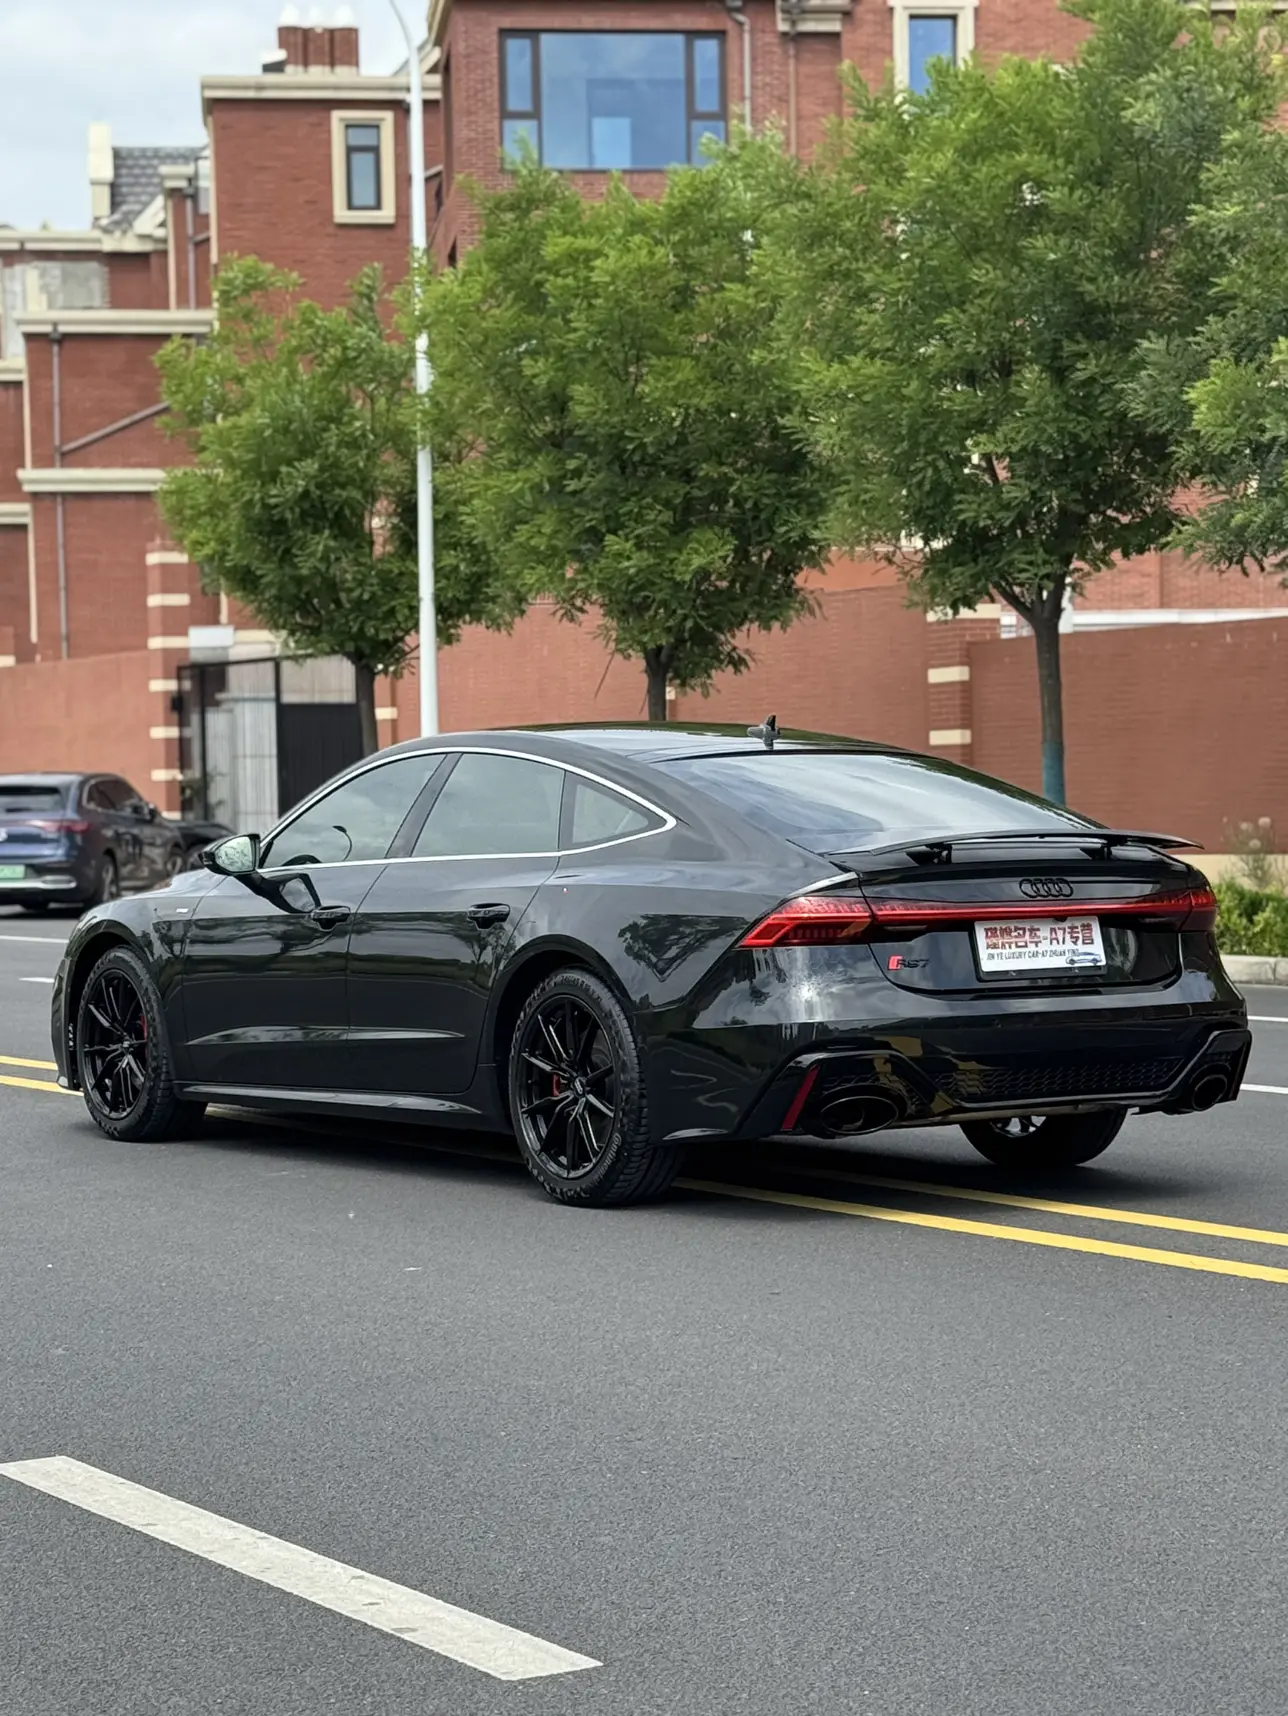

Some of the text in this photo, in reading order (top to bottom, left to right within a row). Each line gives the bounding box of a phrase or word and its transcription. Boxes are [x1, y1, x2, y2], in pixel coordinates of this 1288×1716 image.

[997, 952, 1003, 960] YE
[1004, 950, 1027, 960] LUXURY
[893, 957, 930, 969] RS7
